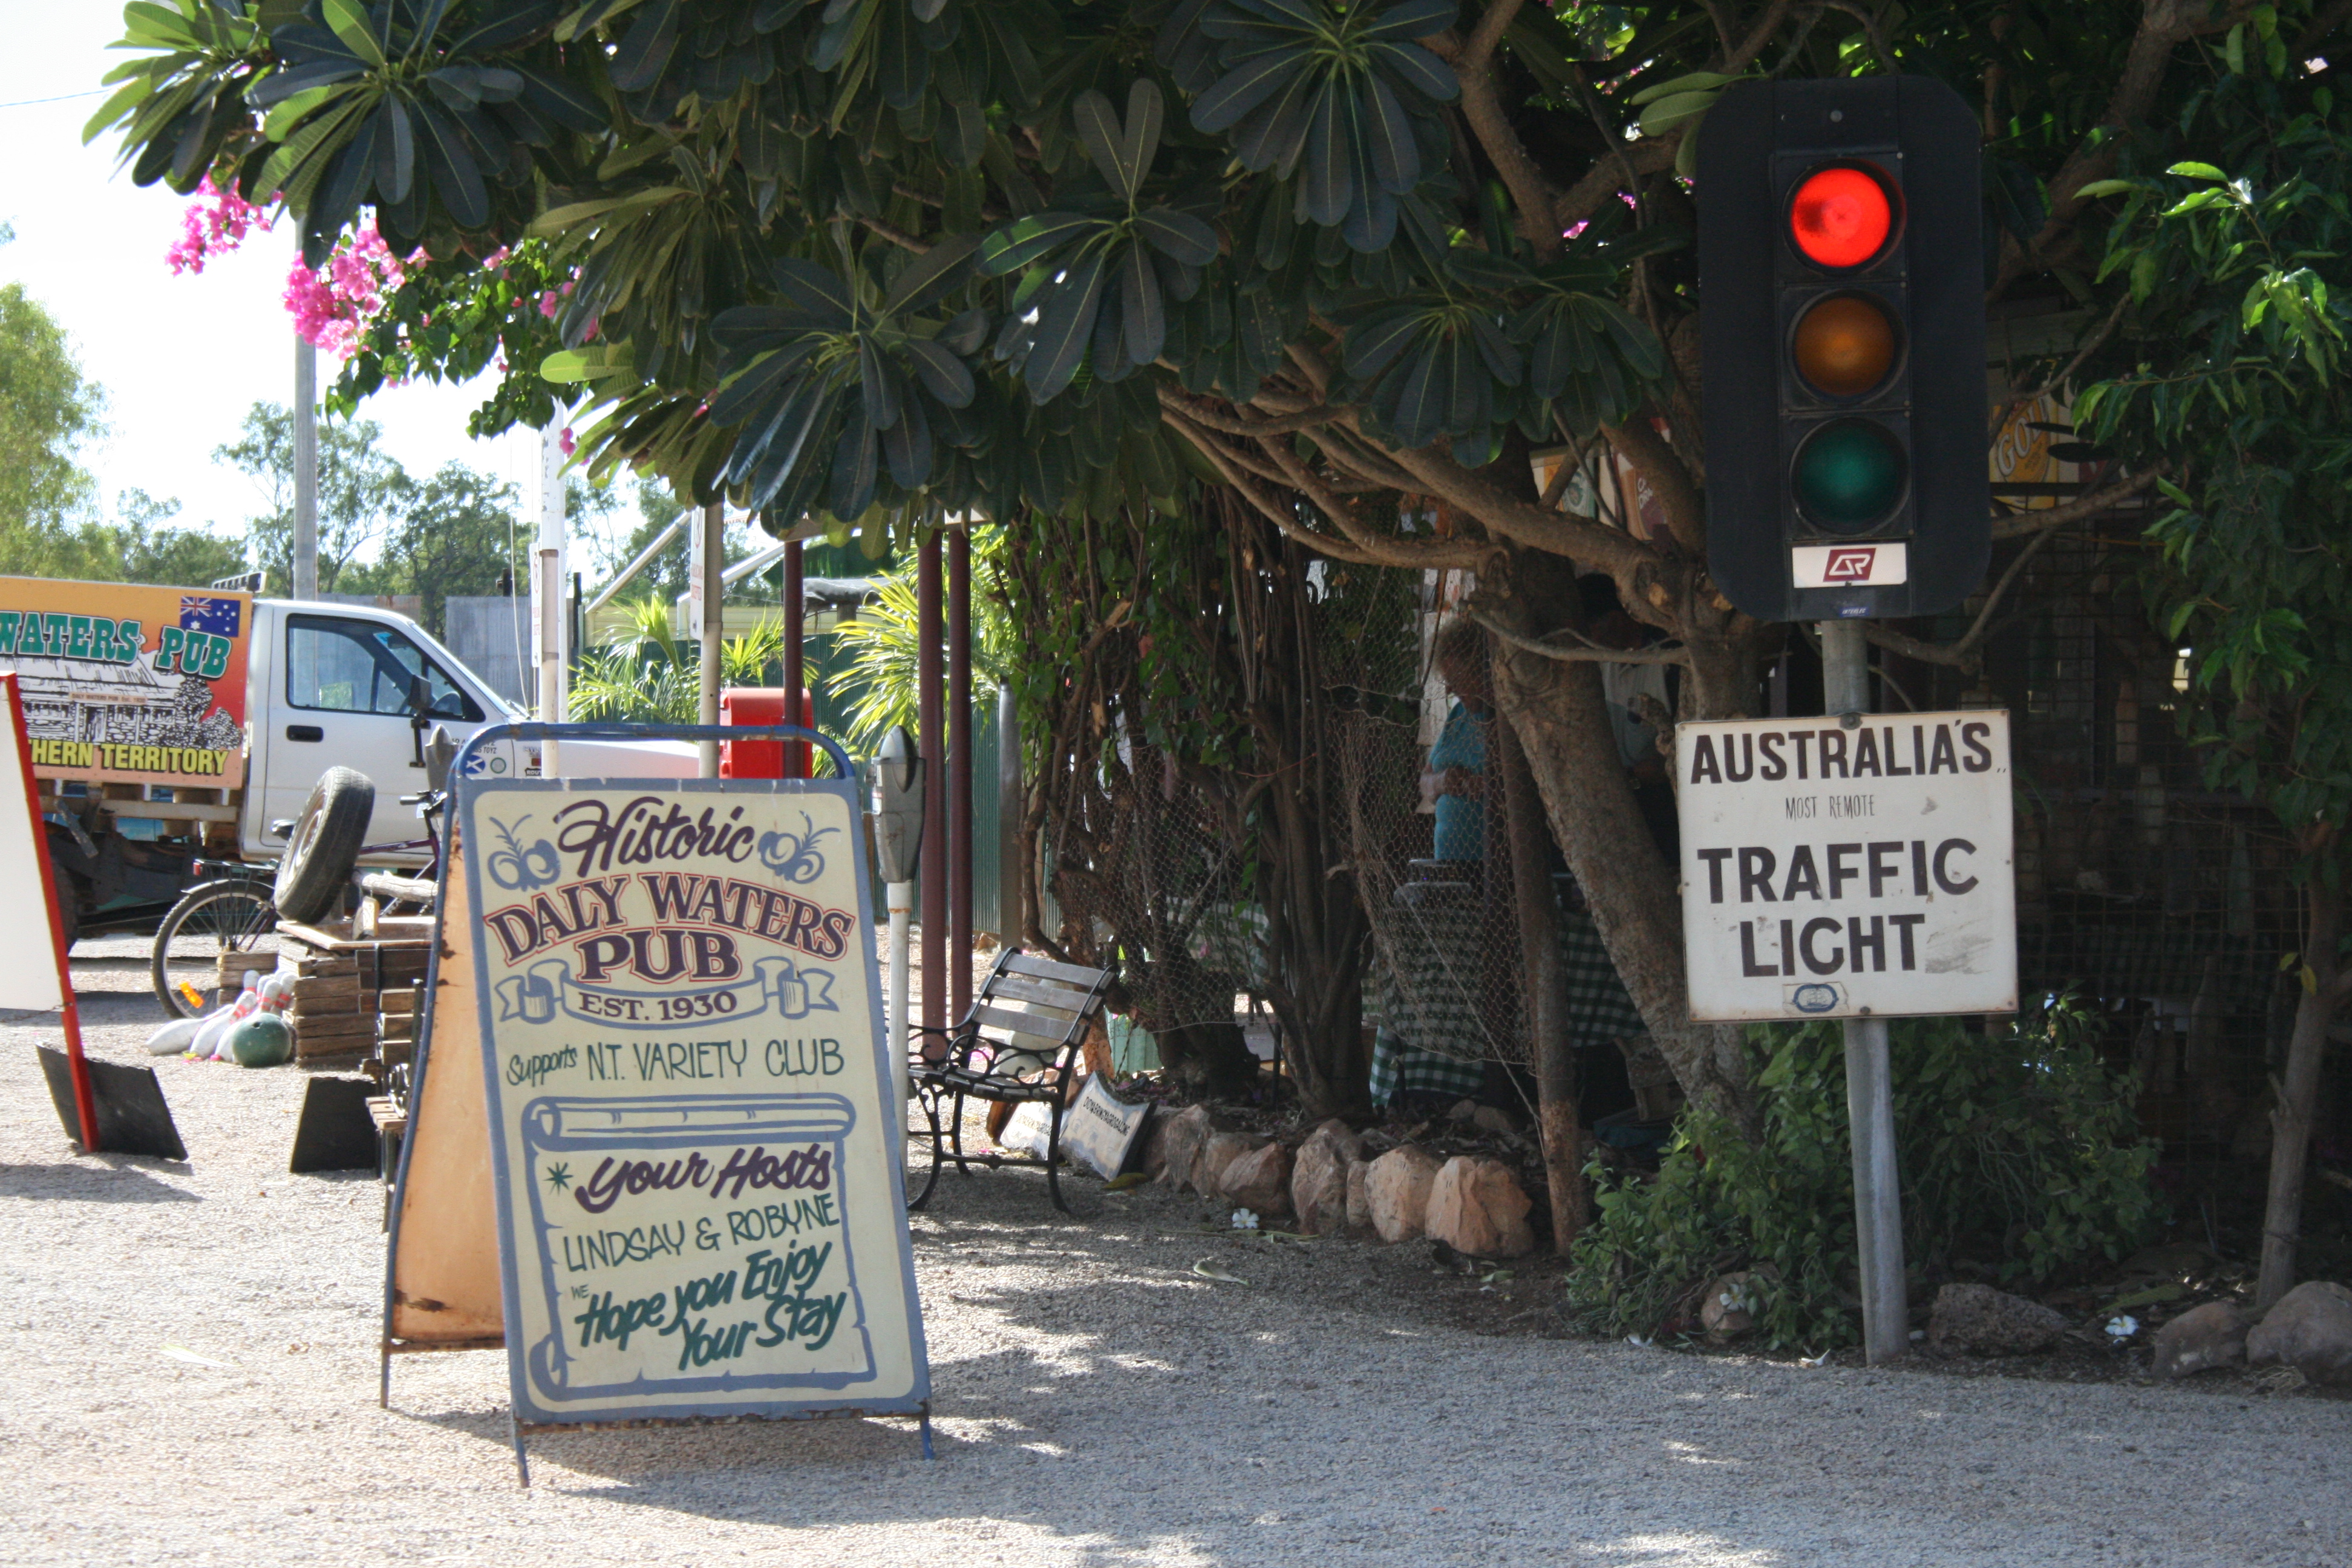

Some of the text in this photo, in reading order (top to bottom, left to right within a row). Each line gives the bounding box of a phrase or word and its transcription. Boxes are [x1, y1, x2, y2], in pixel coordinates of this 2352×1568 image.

[155, 626, 232, 679] PUB
[100, 743, 230, 774] TERRITORY
[553, 796, 755, 877] Historic
[1785, 794, 1876, 821] MOST REMOTE
[1697, 838, 1979, 904] TRAFFIC
[484, 872, 855, 967] DALY WATERS
[1739, 913, 1926, 978] LIGHT
[576, 927, 742, 985] PUB
[578, 991, 737, 1021] EST. 1930
[506, 1039, 844, 1087] Supports N.T. VARIETY CLUB
[710, 1143, 833, 1200] Hosts
[563, 1193, 840, 1272] LINDSAY & ROBYNE
[572, 1240, 833, 1351] WE Hope you Enjoy
[677, 1292, 846, 1371] Your Stay
